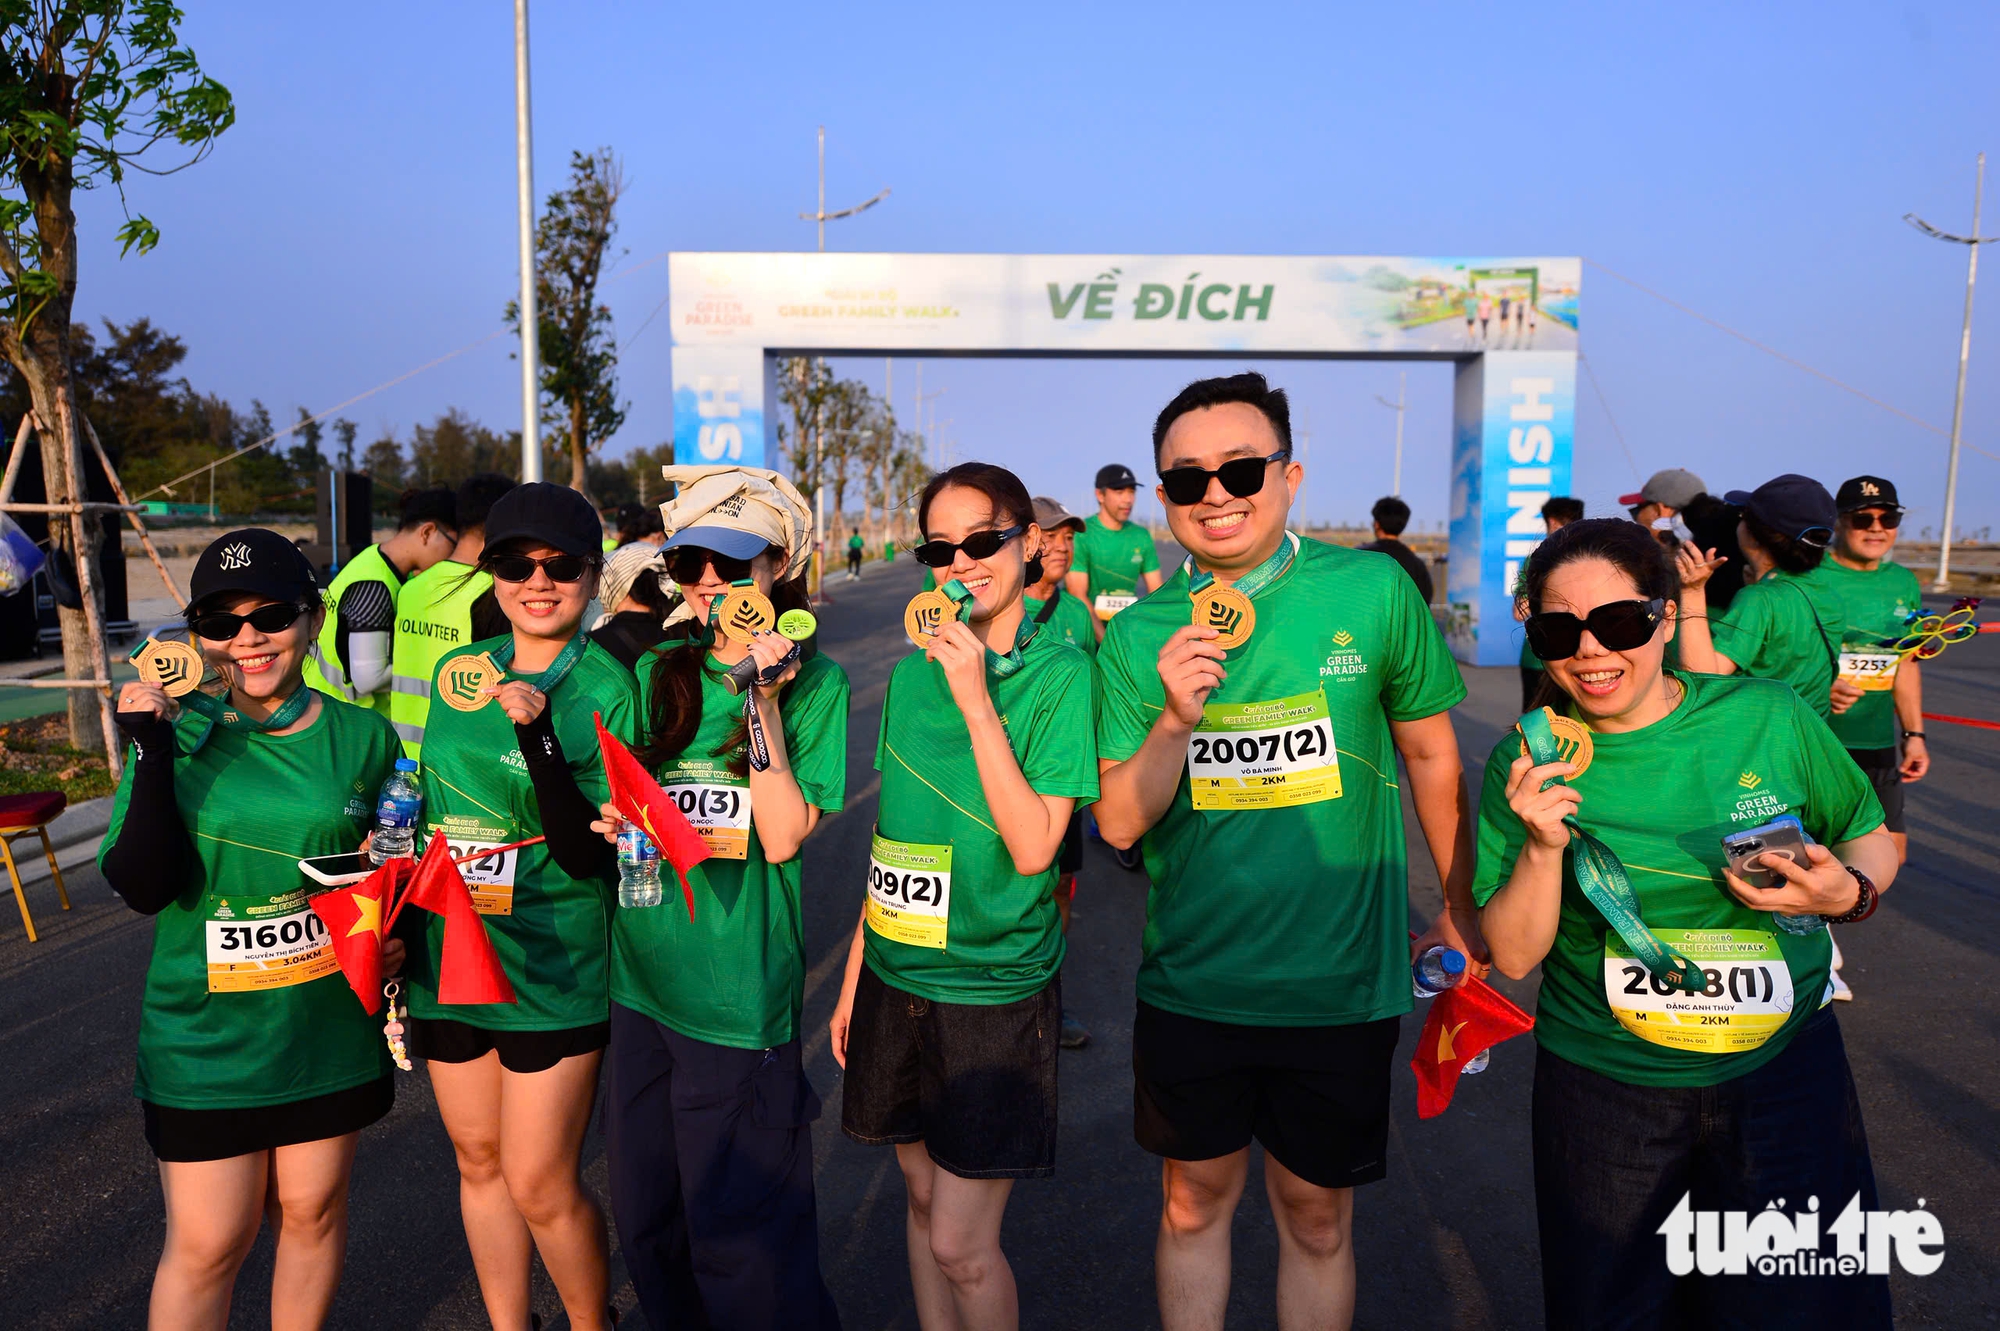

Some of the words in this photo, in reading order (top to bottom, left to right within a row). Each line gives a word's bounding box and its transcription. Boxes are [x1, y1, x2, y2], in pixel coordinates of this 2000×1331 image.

[1047, 267, 1122, 320] VỀ
[1132, 271, 1275, 321] ĐÍCH
[777, 305, 834, 318] GREEN
[837, 305, 898, 318] FAMILY
[399, 618, 460, 643] VOLUNTEER
[1326, 654, 1362, 666] GREEN
[1848, 658, 1888, 672] 3253
[1319, 664, 1368, 677] PARADISE
[1223, 716, 1252, 725] GREEN
[1253, 711, 1286, 723] FAMILY
[1288, 705, 1313, 717] WALK
[1191, 724, 1328, 764] 2007(2)
[508, 749, 525, 760] GRE
[683, 769, 713, 778] FAMILY
[1210, 779, 1221, 788] M
[1261, 776, 1287, 786] 2KM
[1736, 794, 1779, 811] GREEN
[1730, 803, 1788, 822] PARADISE
[449, 825, 481, 835] FAMILY
[480, 827, 503, 837] WALK
[883, 850, 908, 861] FAMILY
[910, 856, 935, 864] WALK
[247, 905, 278, 915] GREEN
[888, 900, 907, 910] TRUNG
[1591, 890, 1630, 929] FAMILY
[881, 907, 898, 919] 2KM
[220, 912, 331, 951] 3160(1
[288, 946, 305, 956] BÍCH
[1627, 927, 1660, 966] GREEN
[1695, 943, 1734, 952] FAMILY
[1736, 943, 1765, 952] WALK
[229, 964, 236, 972] F
[283, 949, 322, 967] 3.04KM
[1692, 1003, 1712, 1011] ANH
[1635, 1012, 1647, 1021] M
[1700, 1015, 1730, 1026] 2KM
